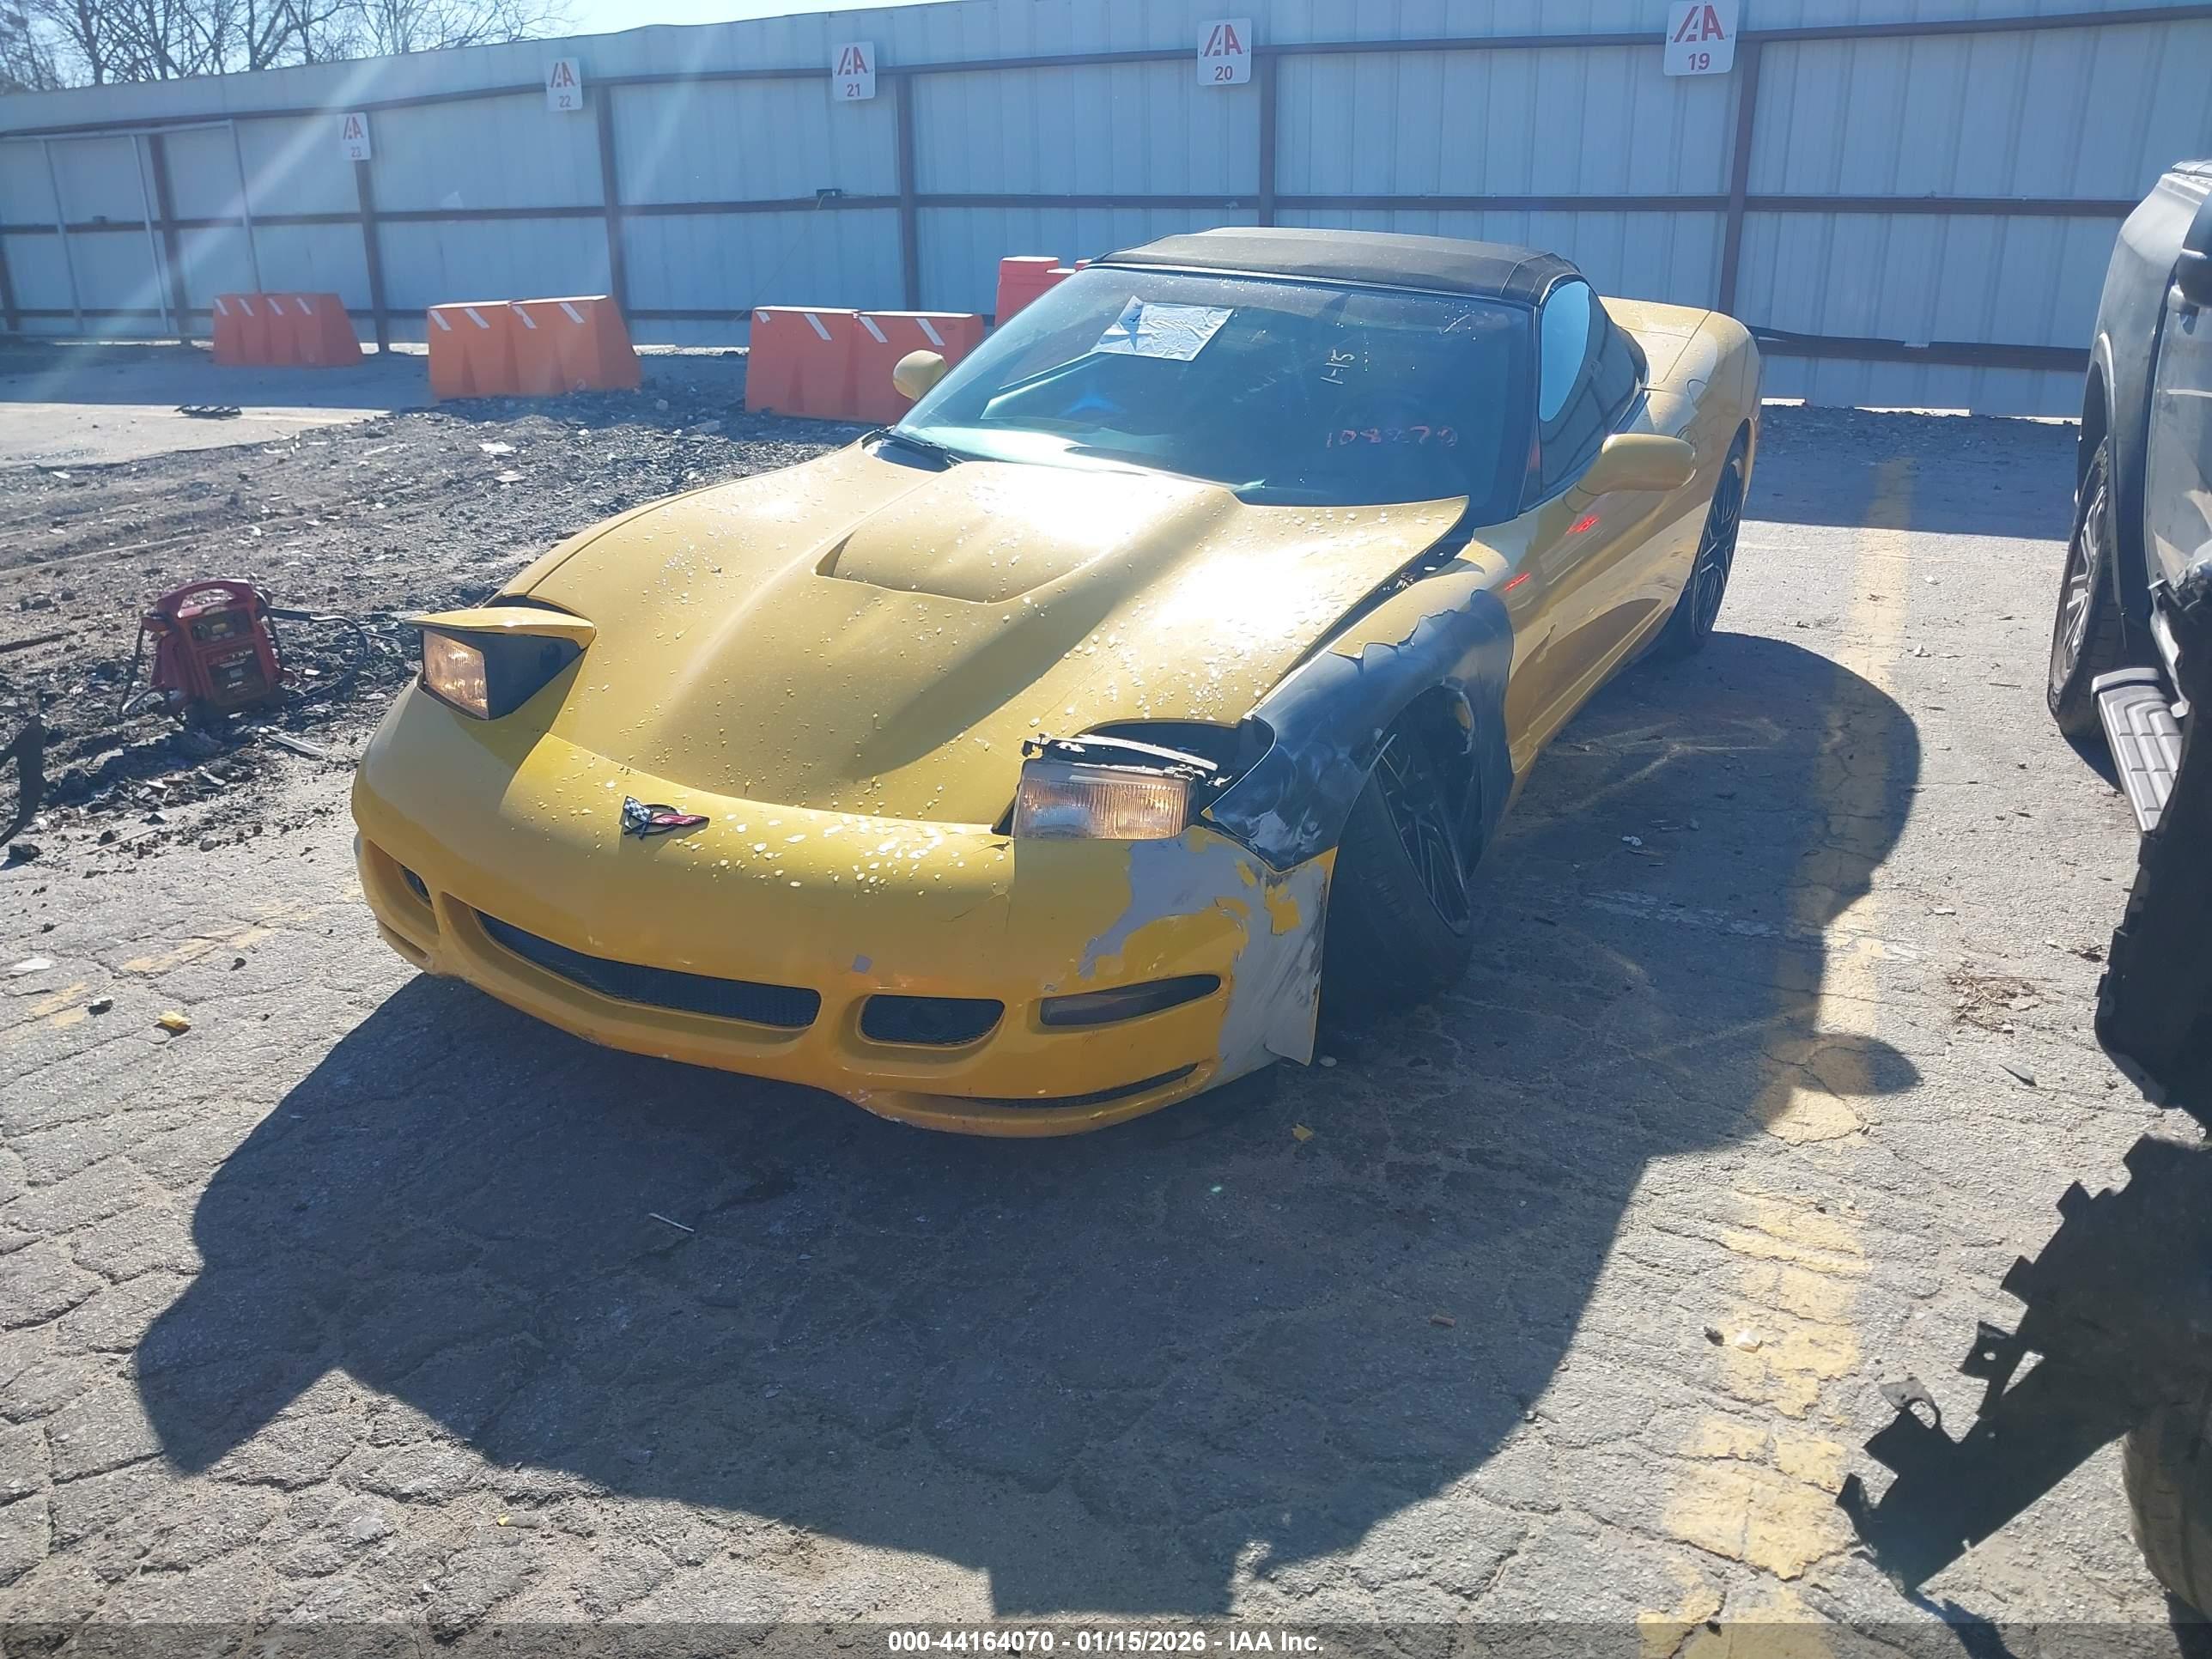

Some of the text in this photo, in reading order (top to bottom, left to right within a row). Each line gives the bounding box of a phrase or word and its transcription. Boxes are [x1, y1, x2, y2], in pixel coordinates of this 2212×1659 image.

[1688, 52, 1711, 70] 19
[1214, 65, 1233, 82] 20
[847, 83, 860, 97] 21
[559, 95, 571, 107] 22
